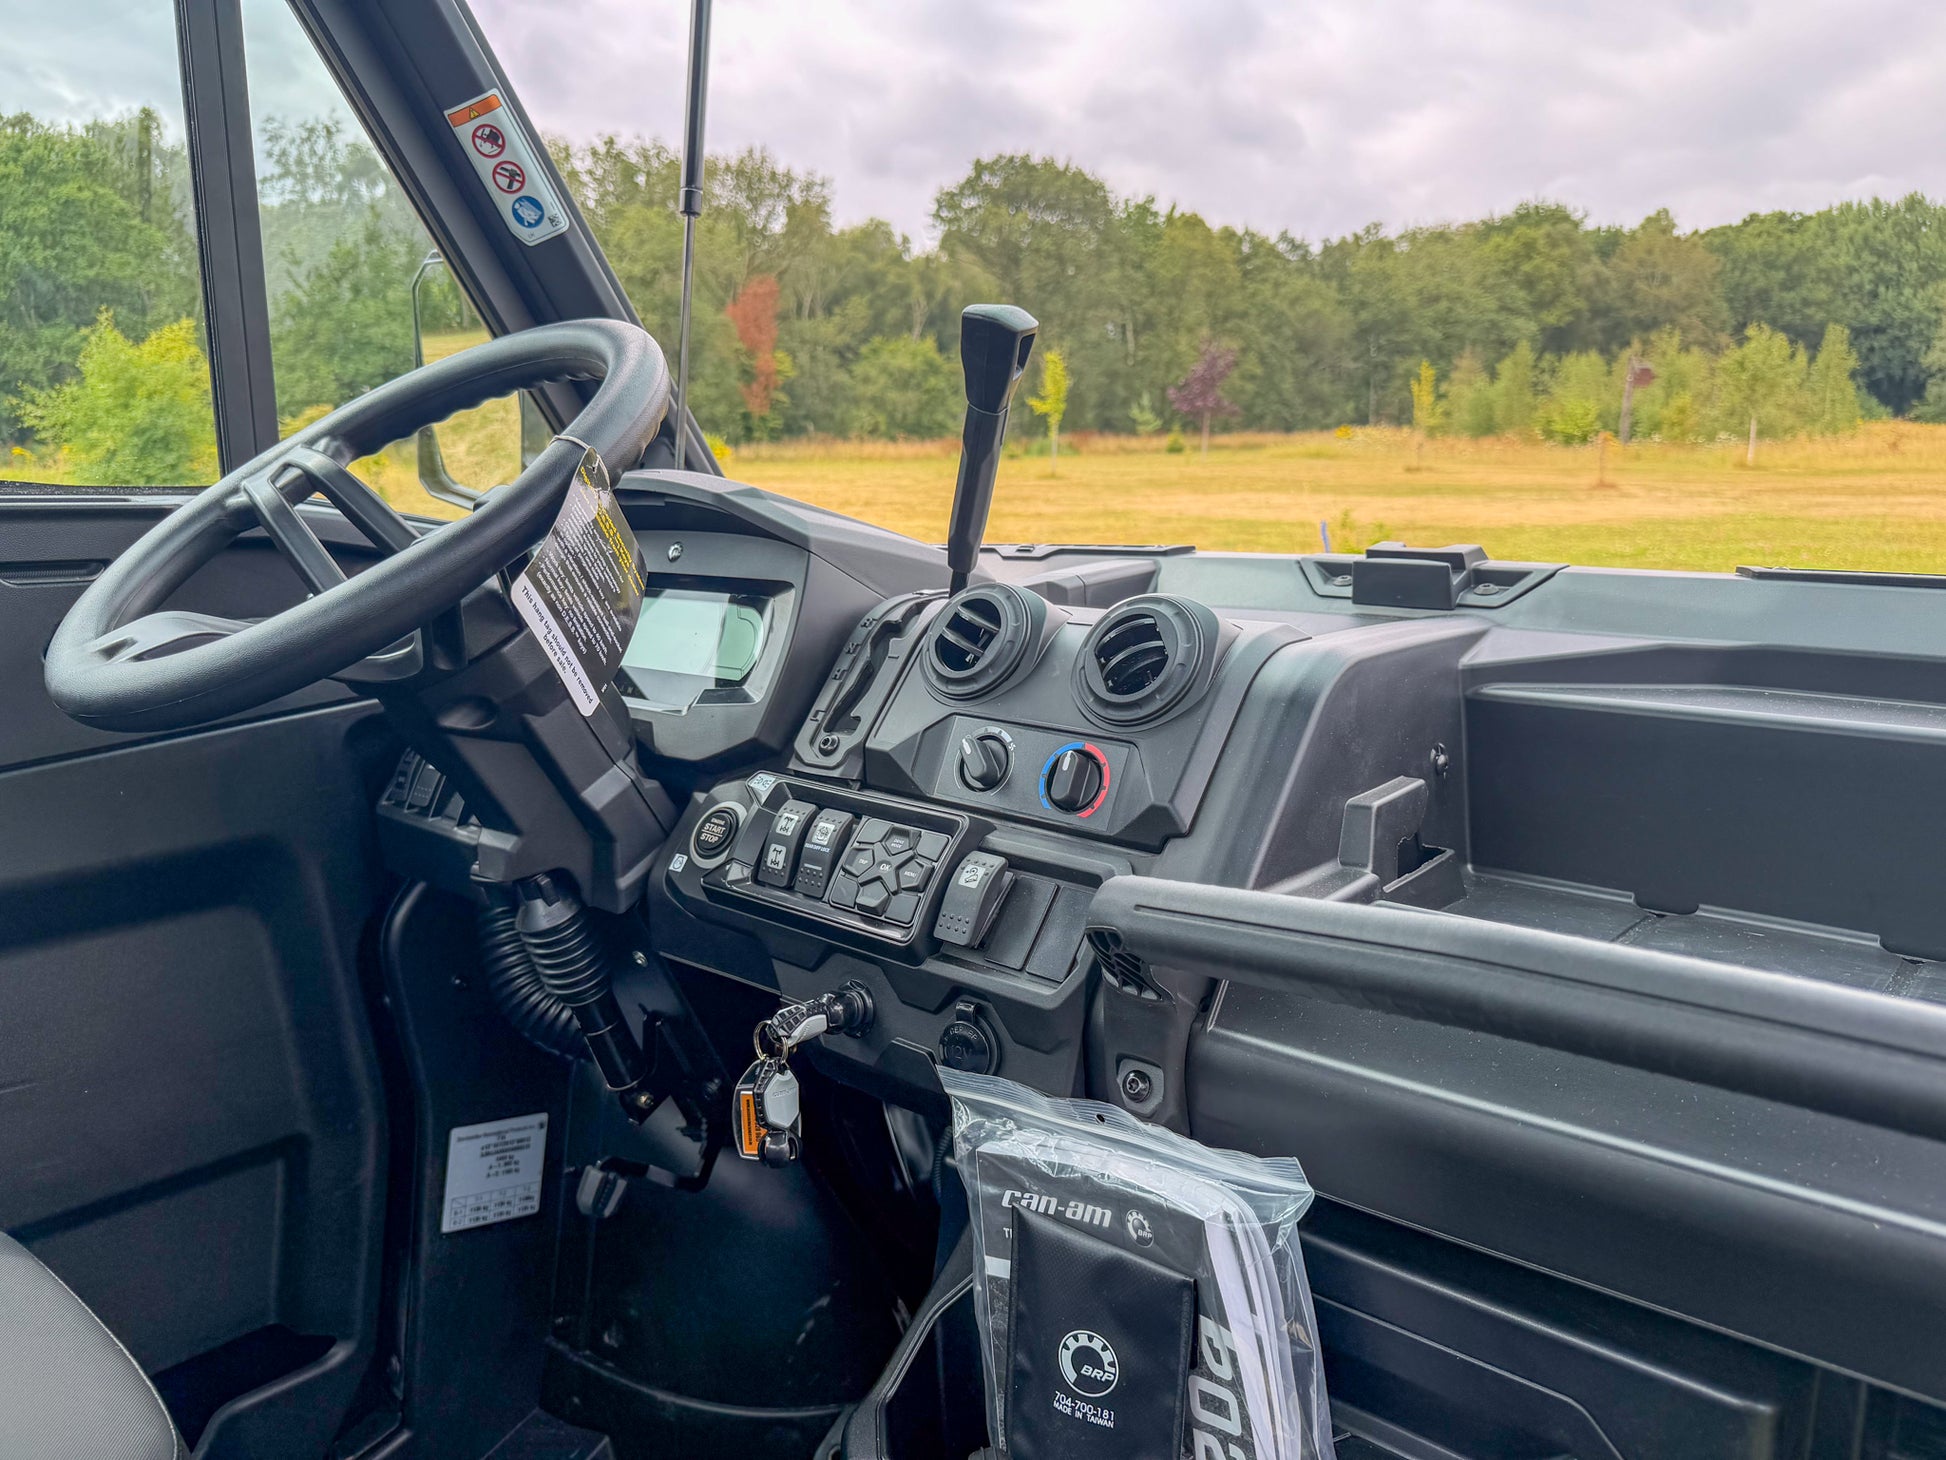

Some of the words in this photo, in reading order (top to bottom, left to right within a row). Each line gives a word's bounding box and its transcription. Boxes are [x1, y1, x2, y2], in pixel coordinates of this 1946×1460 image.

[520, 584, 535, 604] This
[530, 602, 546, 623] hang
[541, 619, 553, 635] tag
[541, 633, 559, 658] before
[554, 654, 569, 674] sale.
[550, 632, 567, 657] should
[563, 655, 573, 669] not
[570, 666, 579, 678] be
[574, 676, 594, 704] removed
[700, 832, 719, 843] STOP
[704, 822, 726, 834] START
[880, 863, 891, 871] OK
[1001, 1189, 1113, 1228] can-am
[1080, 1364, 1115, 1382] BRP
[1053, 1400, 1072, 1416] MADE
[1074, 1410, 1083, 1420] IN
[1086, 1414, 1115, 1429] TAIWAN
[1055, 1390, 1115, 1421] 704-700-181
